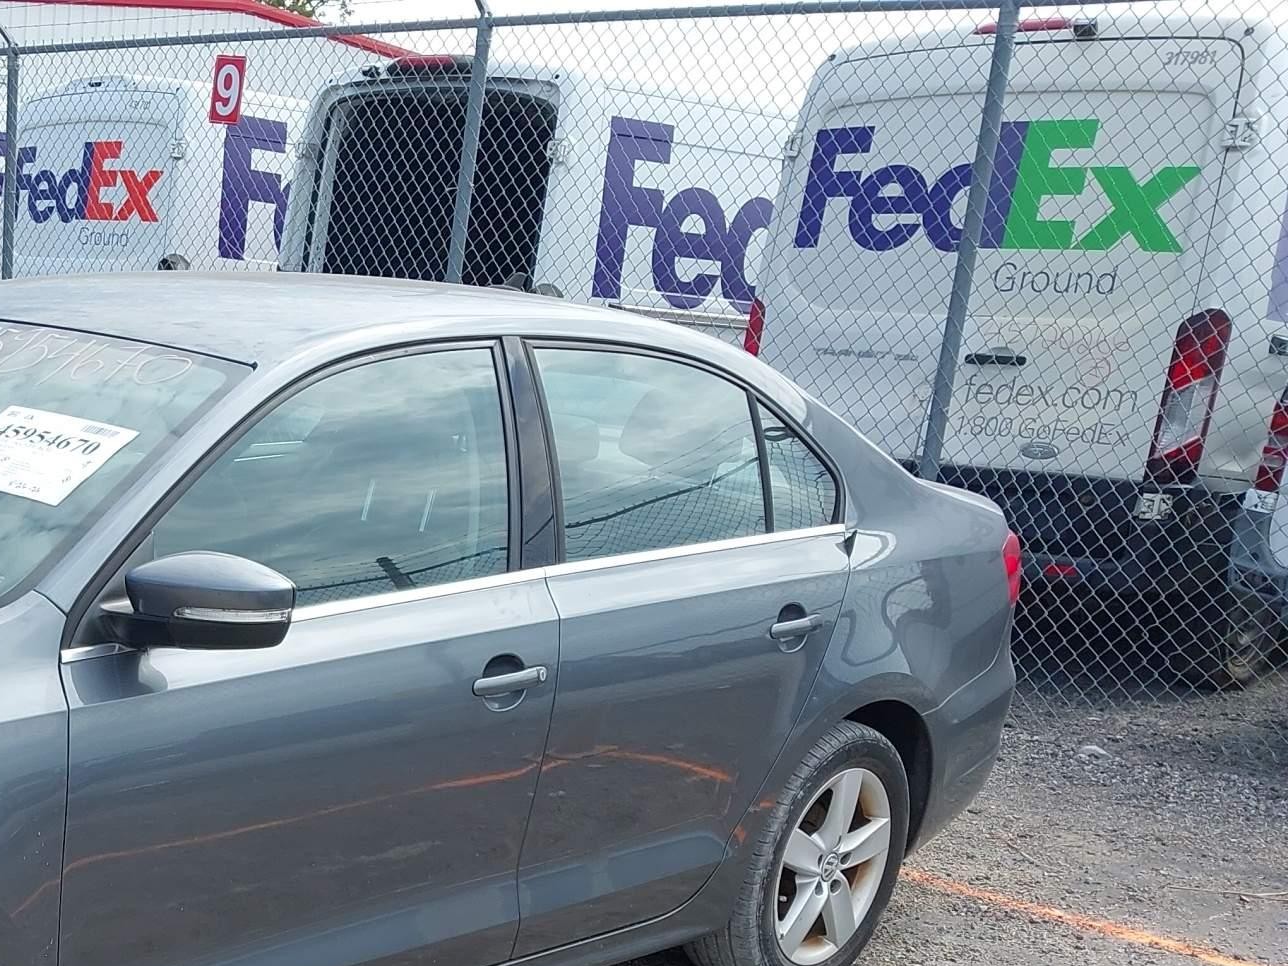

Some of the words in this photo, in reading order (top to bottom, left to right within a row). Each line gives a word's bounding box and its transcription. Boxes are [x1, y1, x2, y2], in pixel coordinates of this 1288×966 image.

[1165, 50, 1217, 66] 317981
[213, 64, 240, 116] 9
[15, 140, 164, 223] FedEx
[218, 115, 290, 260] F
[793, 118, 1202, 254] FedEx
[78, 227, 130, 247] Ground
[993, 262, 1119, 296] Ground
[963, 373, 1139, 412] fedex.com
[1018, 417, 1130, 447] GoFedEx
